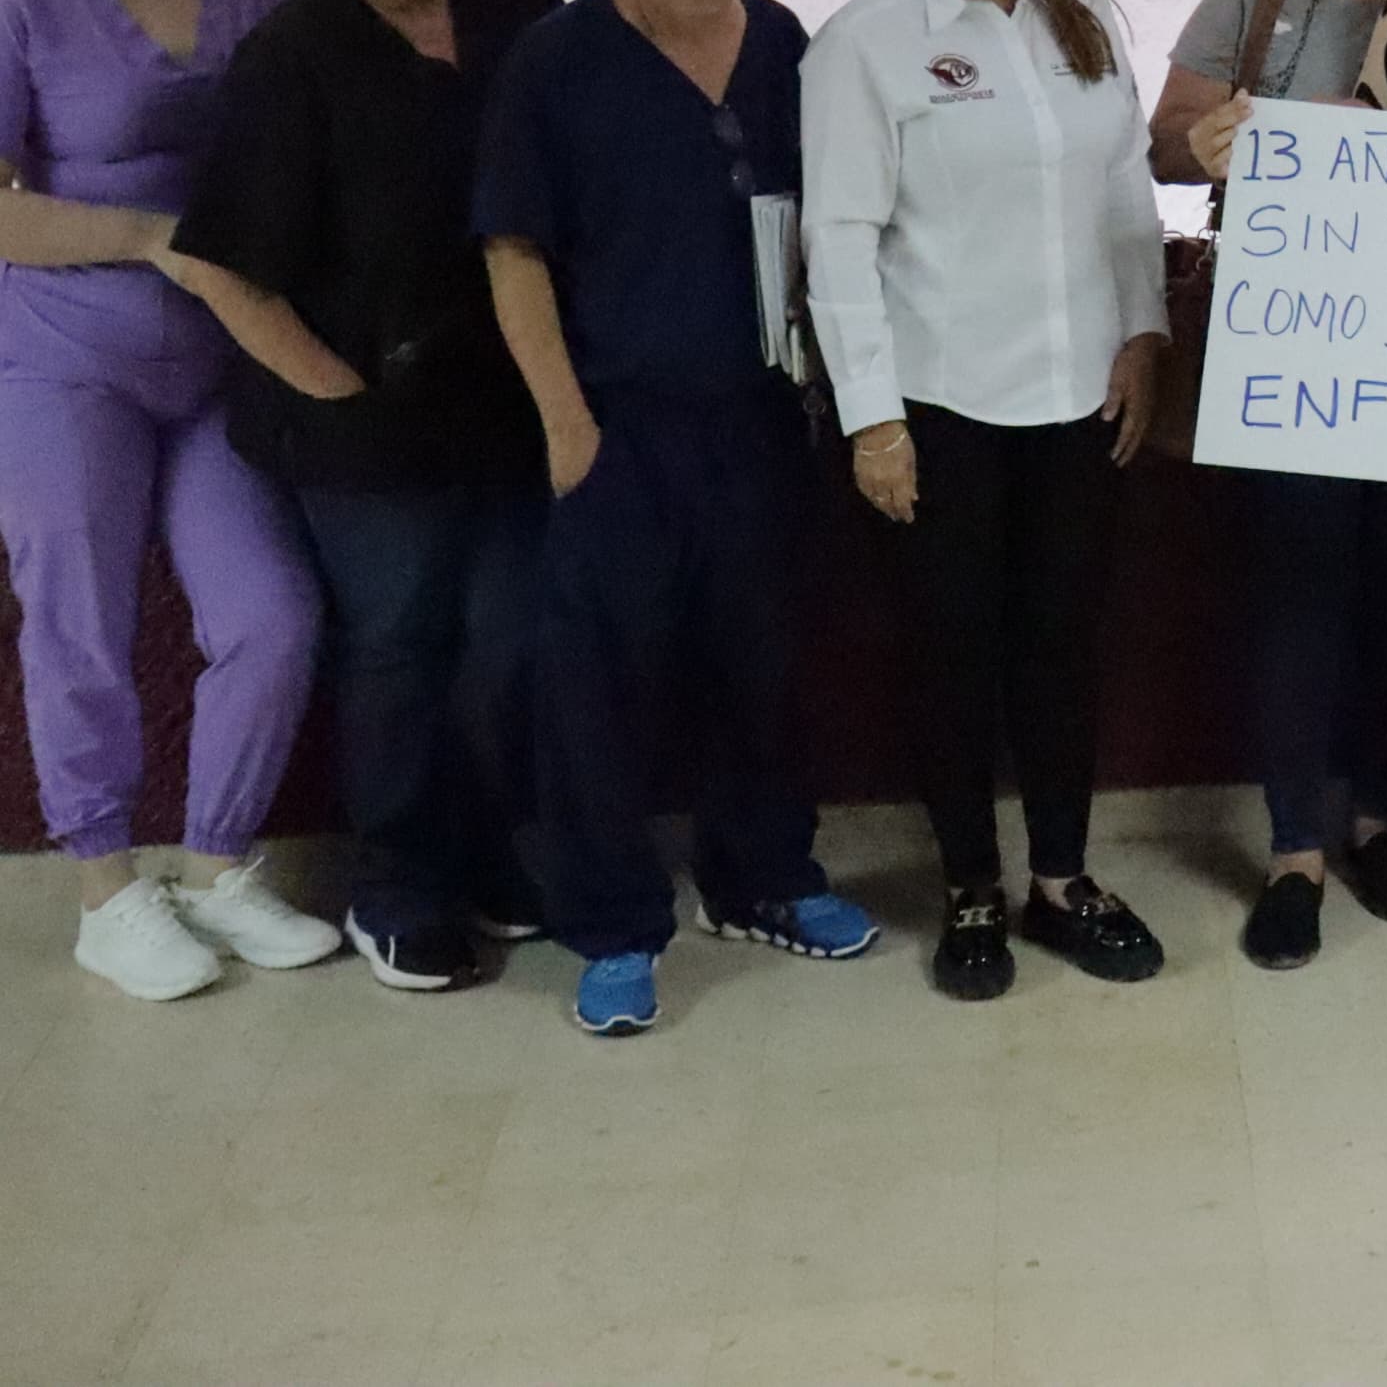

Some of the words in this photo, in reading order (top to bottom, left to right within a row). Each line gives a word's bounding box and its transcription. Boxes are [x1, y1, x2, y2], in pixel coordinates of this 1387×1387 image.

[1243, 129, 1301, 181] 13
[1242, 204, 1358, 257] SIN
[1226, 281, 1367, 342] COMO
